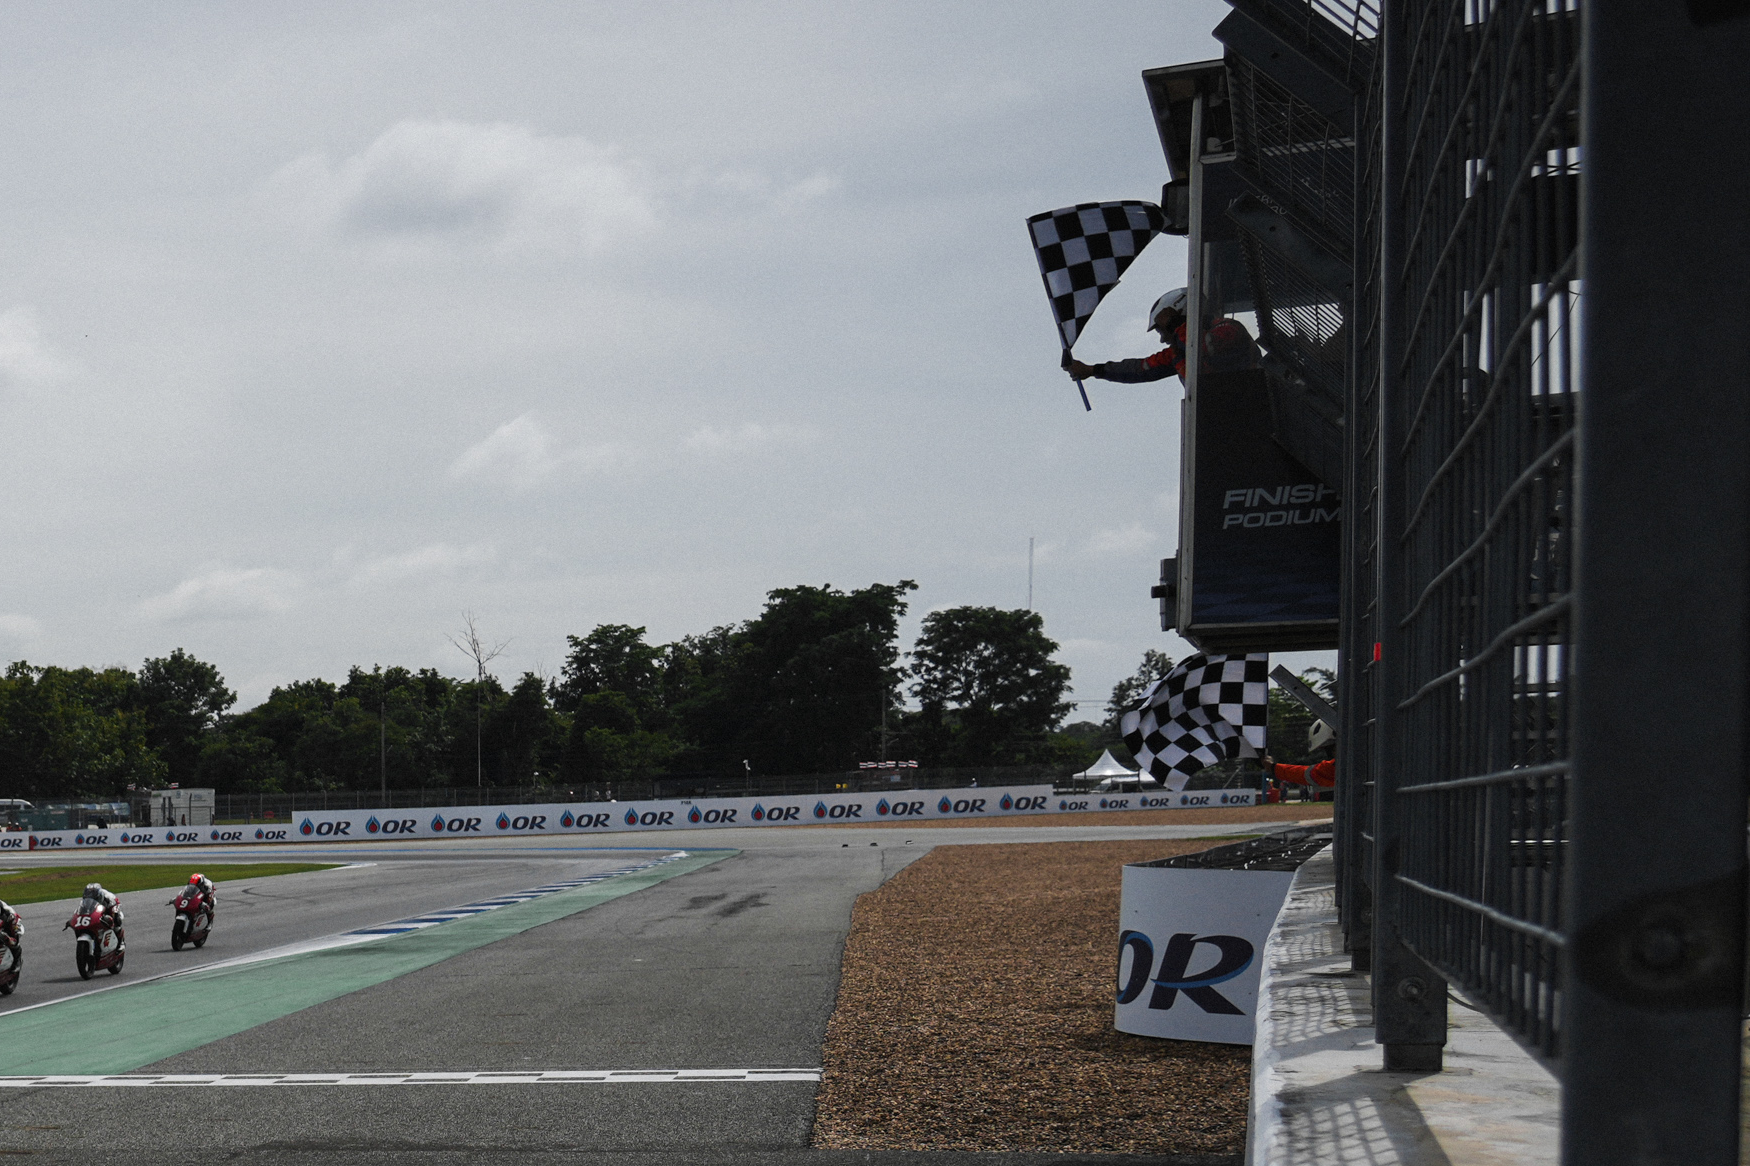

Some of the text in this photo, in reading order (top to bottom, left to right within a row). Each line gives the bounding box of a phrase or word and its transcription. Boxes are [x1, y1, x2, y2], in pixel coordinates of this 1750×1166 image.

[1222, 482, 1342, 510] FINISH
[1222, 507, 1341, 530] PODIUM
[1067, 794, 1250, 810] OR OR OR OR OR
[315, 795, 1047, 835] OR OR OR OR OR OR OR OR OR OR OR OR
[0, 838, 22, 847] OR
[39, 836, 62, 847] OR
[85, 835, 108, 845] OR
[130, 833, 153, 843] OR
[175, 832, 198, 842] OR
[220, 831, 242, 841] OR
[263, 830, 286, 840] OR
[180, 899, 189, 909] 9
[74, 915, 92, 928] 16
